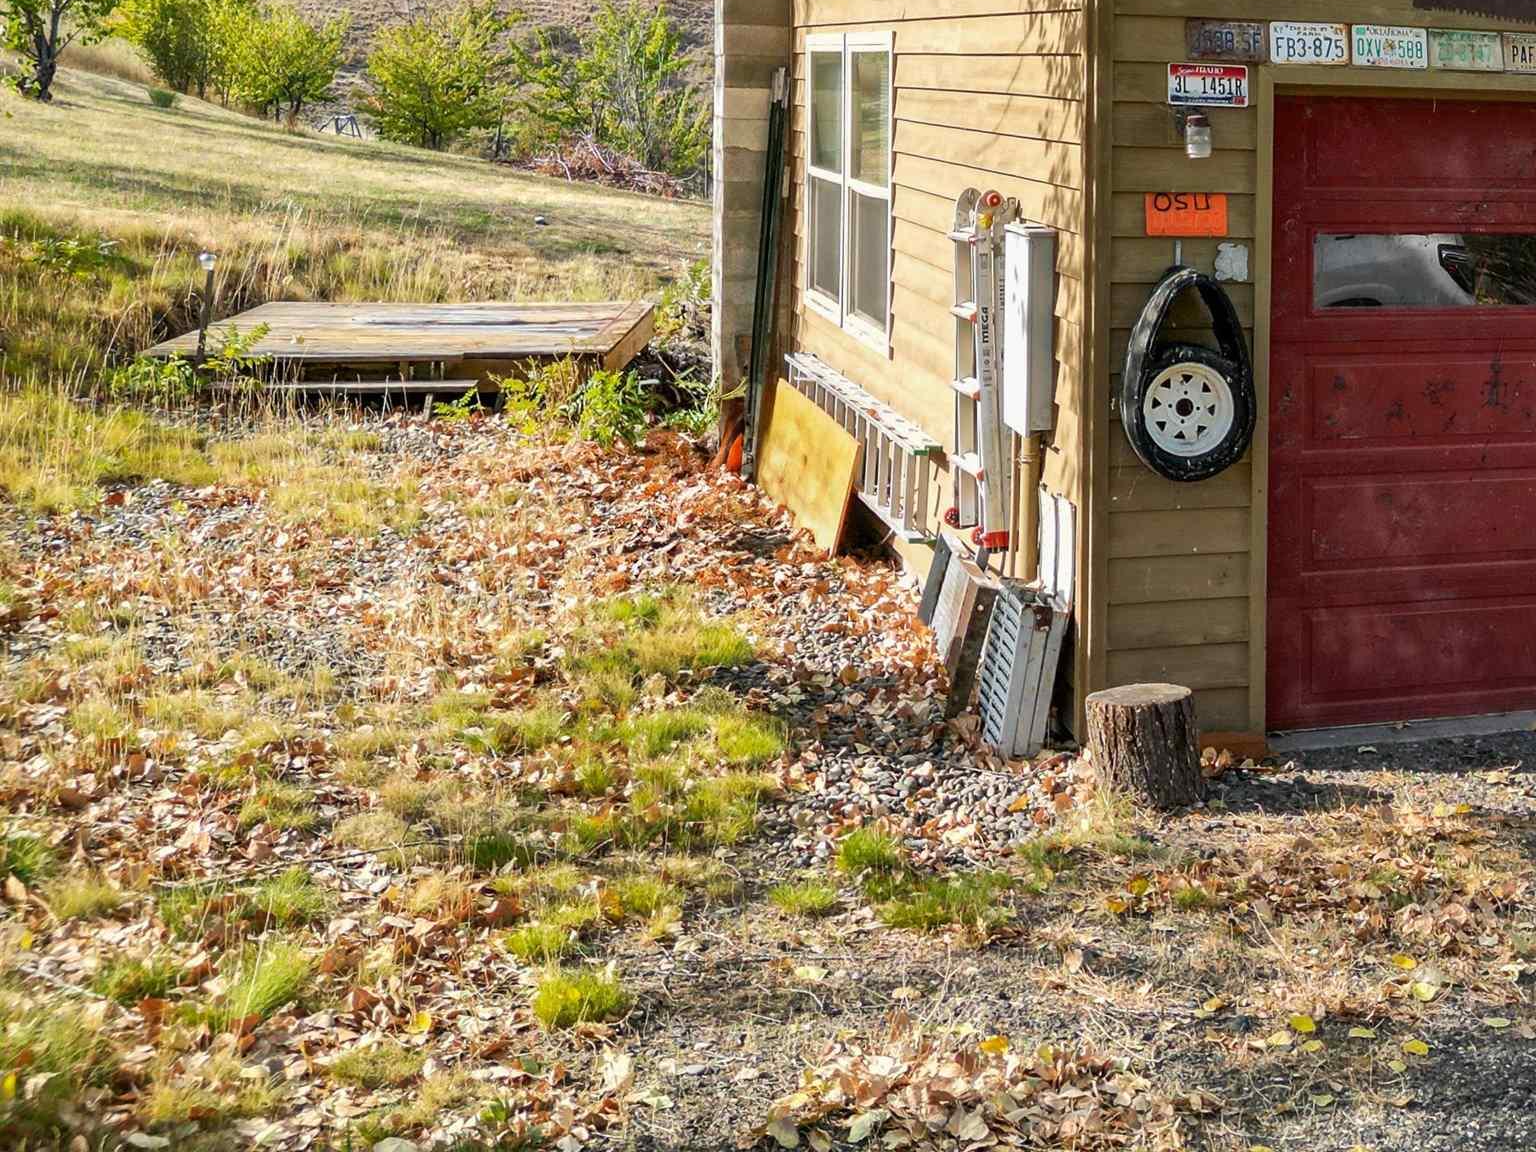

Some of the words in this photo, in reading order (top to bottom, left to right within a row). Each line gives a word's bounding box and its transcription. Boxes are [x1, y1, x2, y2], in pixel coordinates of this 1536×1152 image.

[1174, 75, 1190, 94] 3L
[1201, 76, 1242, 96] 1451R
[981, 306, 989, 344] MEGA
